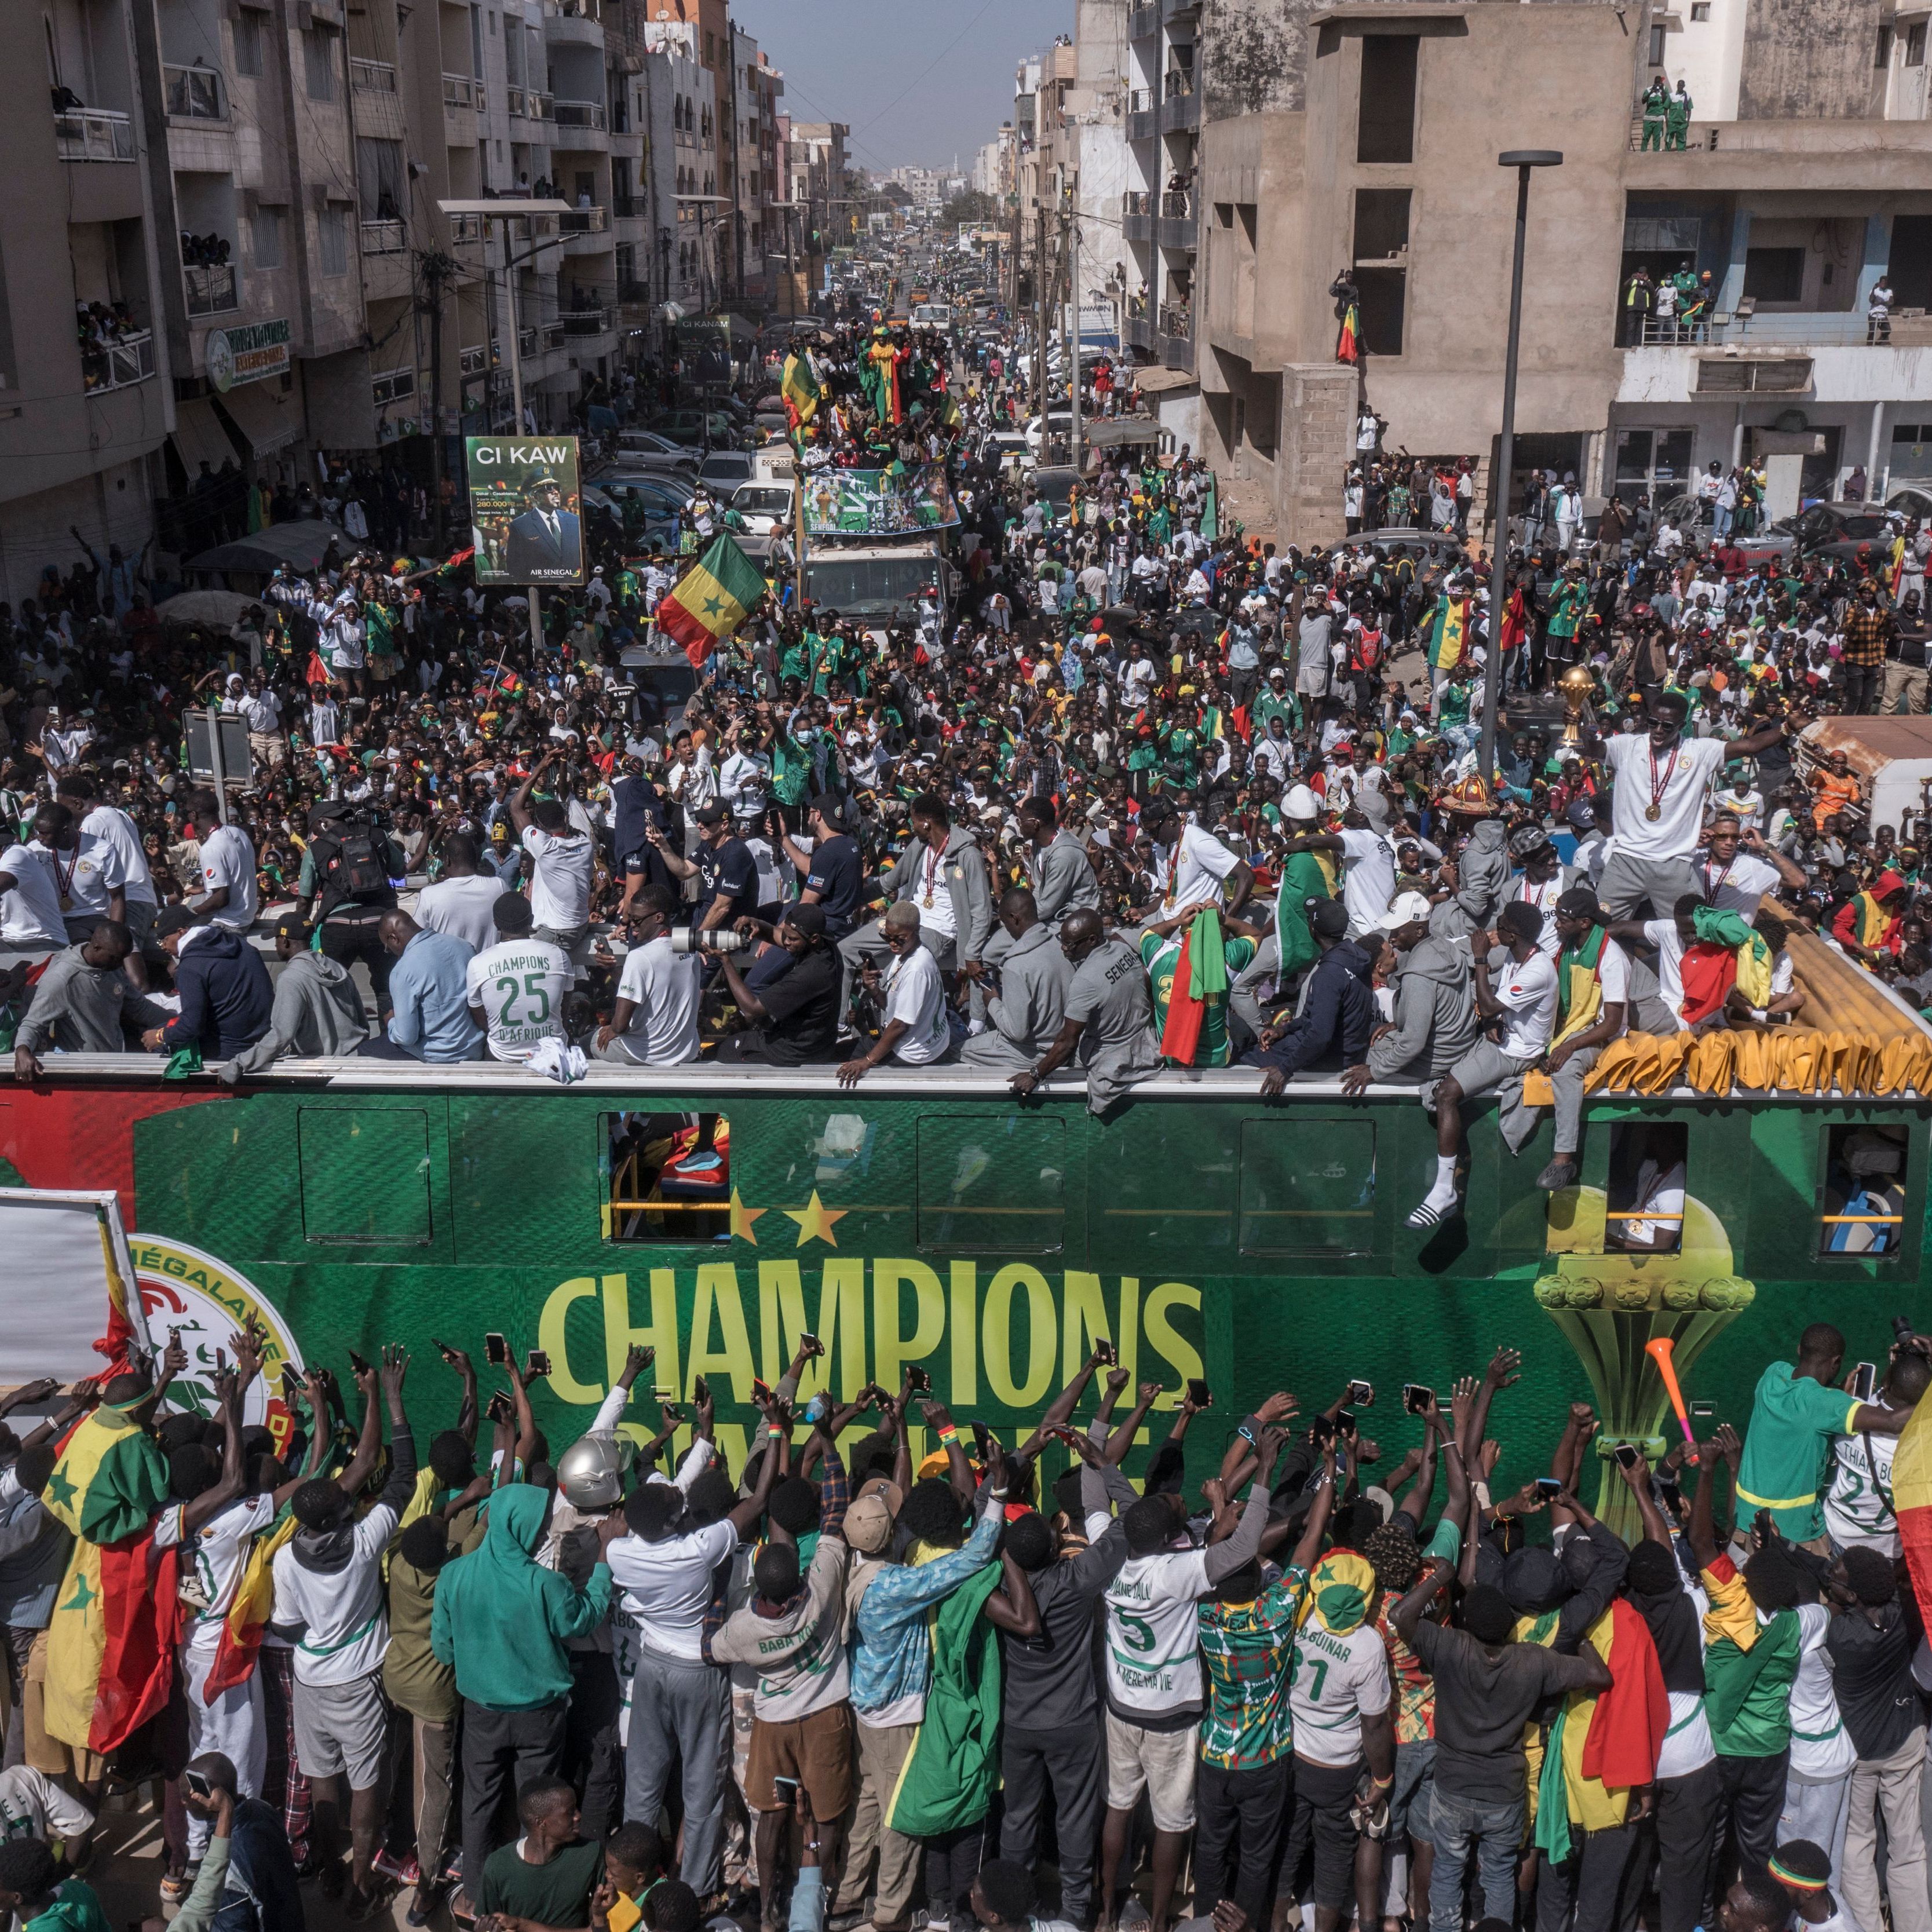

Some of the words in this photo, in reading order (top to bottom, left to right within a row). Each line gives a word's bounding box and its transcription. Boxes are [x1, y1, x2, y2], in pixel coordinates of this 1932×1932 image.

[476, 447, 501, 465] CI
[510, 446, 567, 464] KAW
[488, 954, 550, 977] CHAMPIONS
[1105, 951, 1140, 985] SENEGA
[496, 972, 549, 1027] 25
[538, 1257, 1206, 1412] CHAMPIONS
[759, 1636, 794, 1654] BABA
[1114, 1606, 1156, 1652] 5
[1308, 1631, 1352, 1664] GUINAR
[1123, 1669, 1144, 1688] MERE
[1145, 1676, 1157, 1688] MA
[1160, 1672, 1173, 1691] VIE
